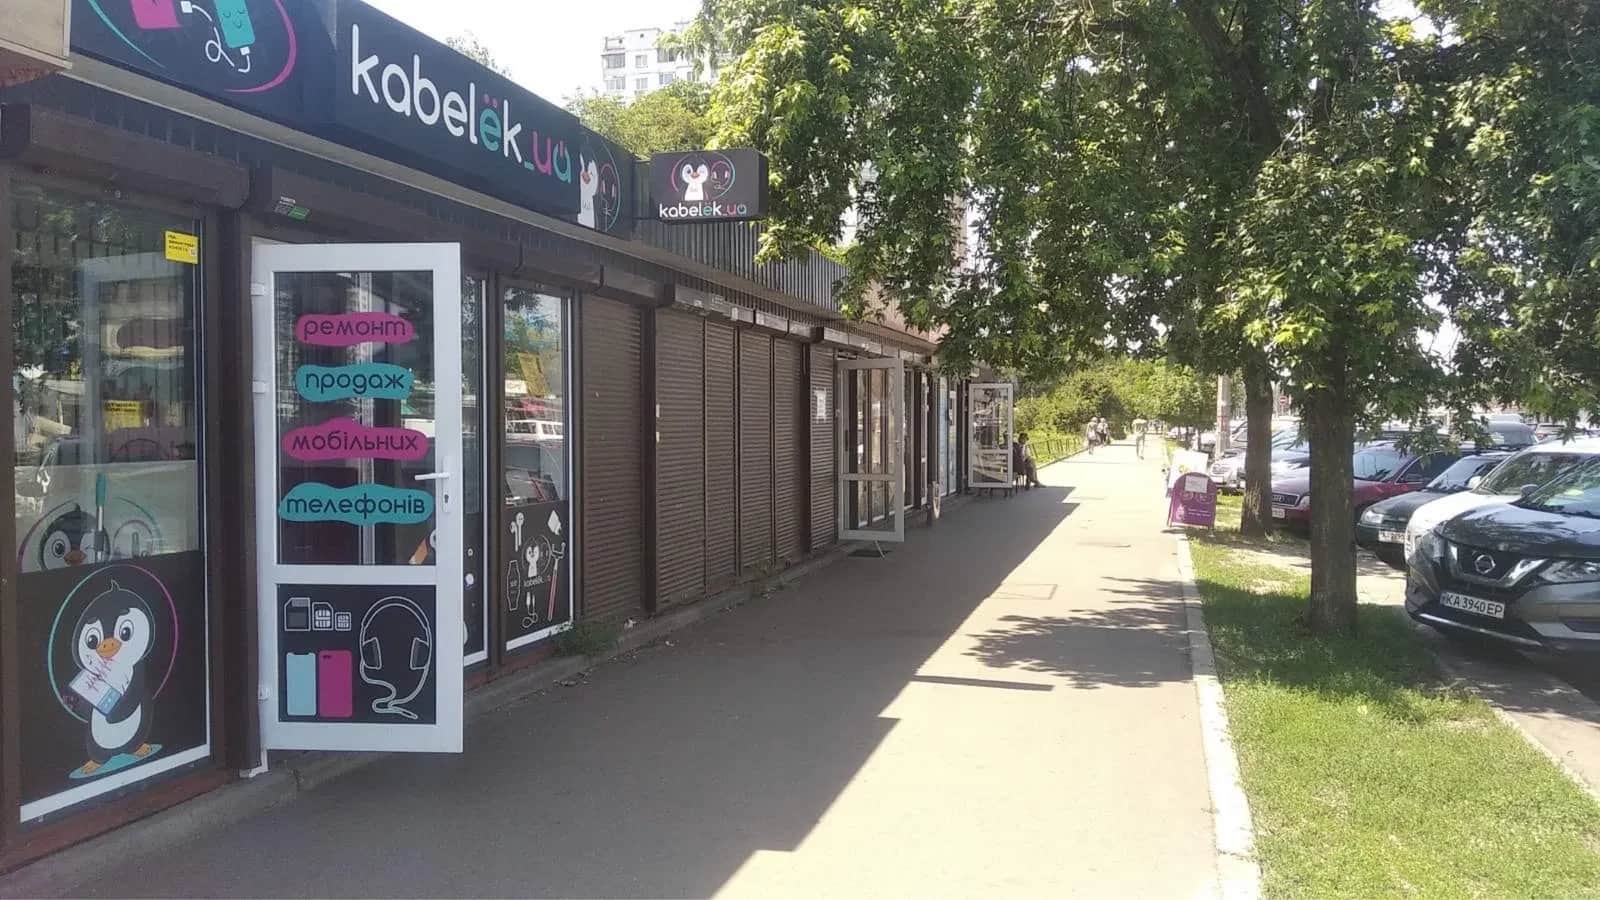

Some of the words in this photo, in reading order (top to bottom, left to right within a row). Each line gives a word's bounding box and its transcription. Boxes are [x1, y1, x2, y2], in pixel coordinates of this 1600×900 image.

[303, 320, 406, 341] ремонт
[305, 373, 405, 394] продаж
[292, 430, 418, 451] мобільних
[286, 493, 426, 519] телефонів
